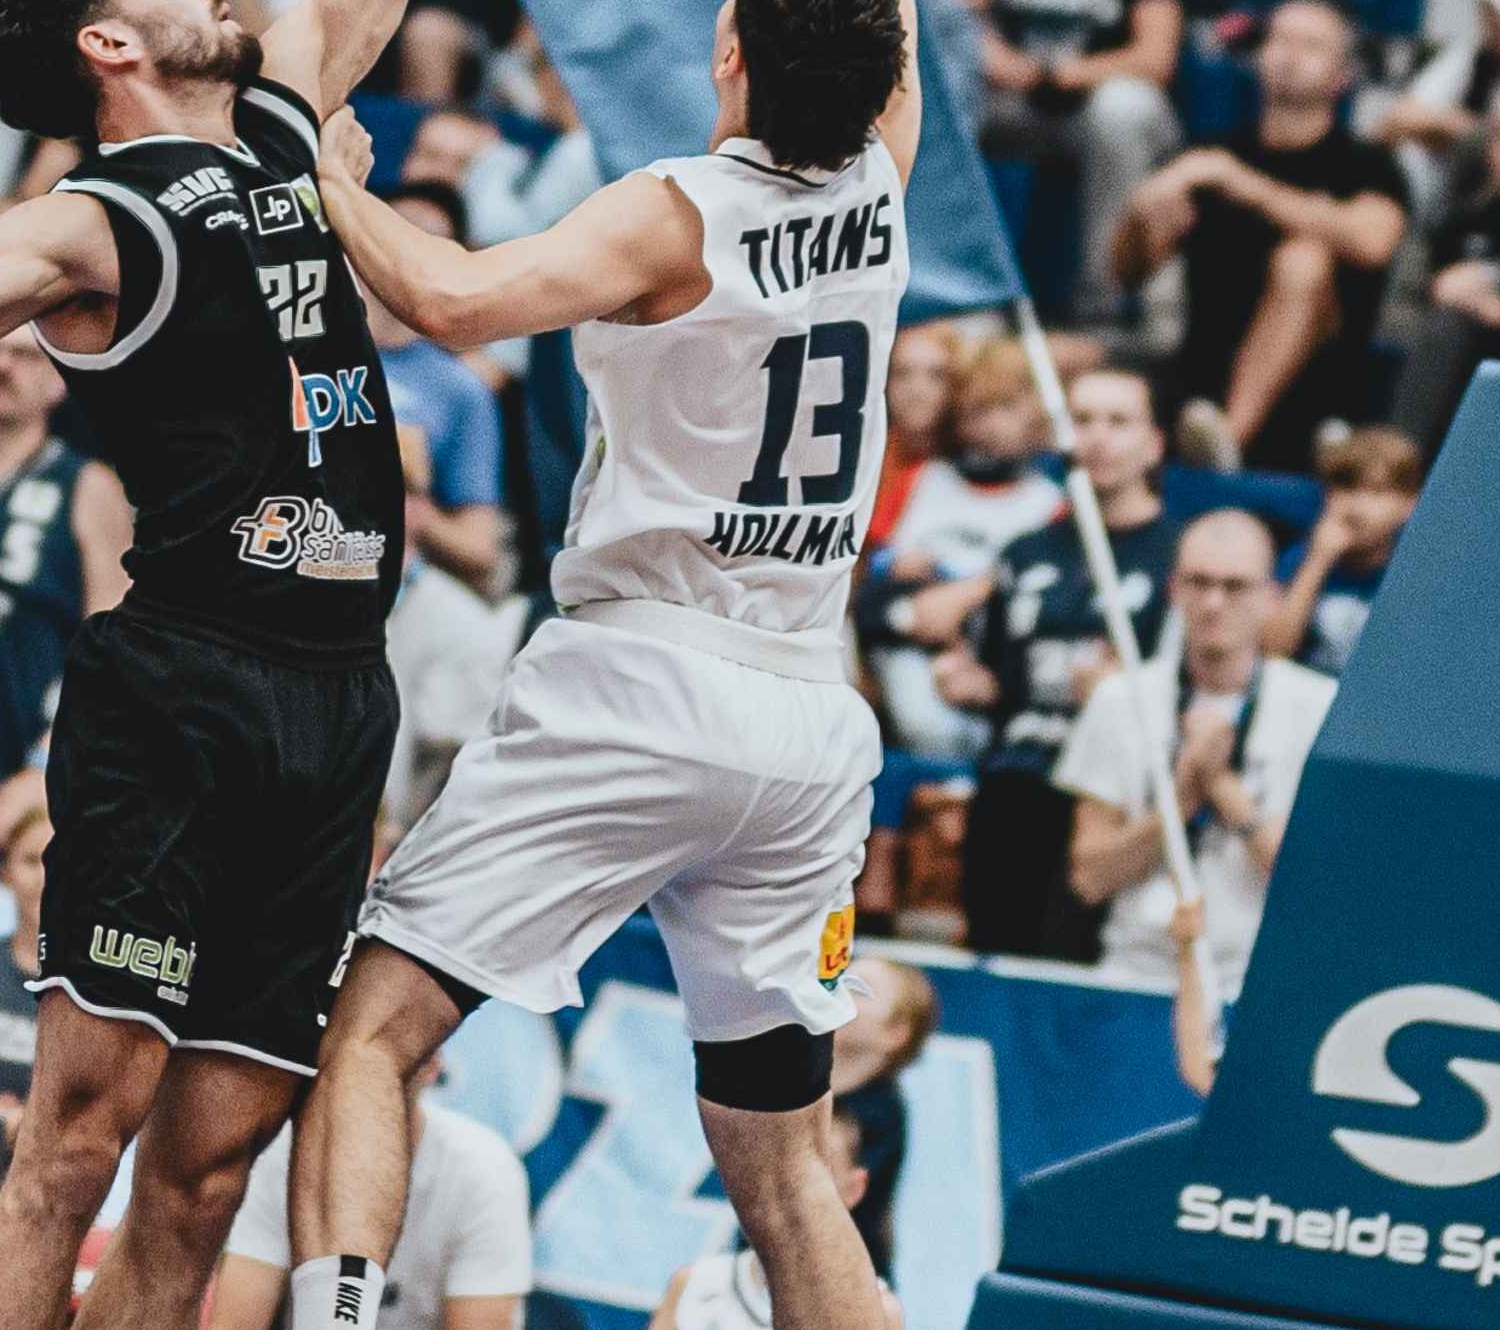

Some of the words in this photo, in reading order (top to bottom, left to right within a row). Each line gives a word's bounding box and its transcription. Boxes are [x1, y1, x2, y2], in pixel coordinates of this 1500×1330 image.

[739, 193, 892, 299] TITANS
[258, 259, 328, 342] 22
[736, 319, 871, 507] 13
[1176, 1183, 1428, 1265] Schelde
[334, 1282, 363, 1325] NIKE
